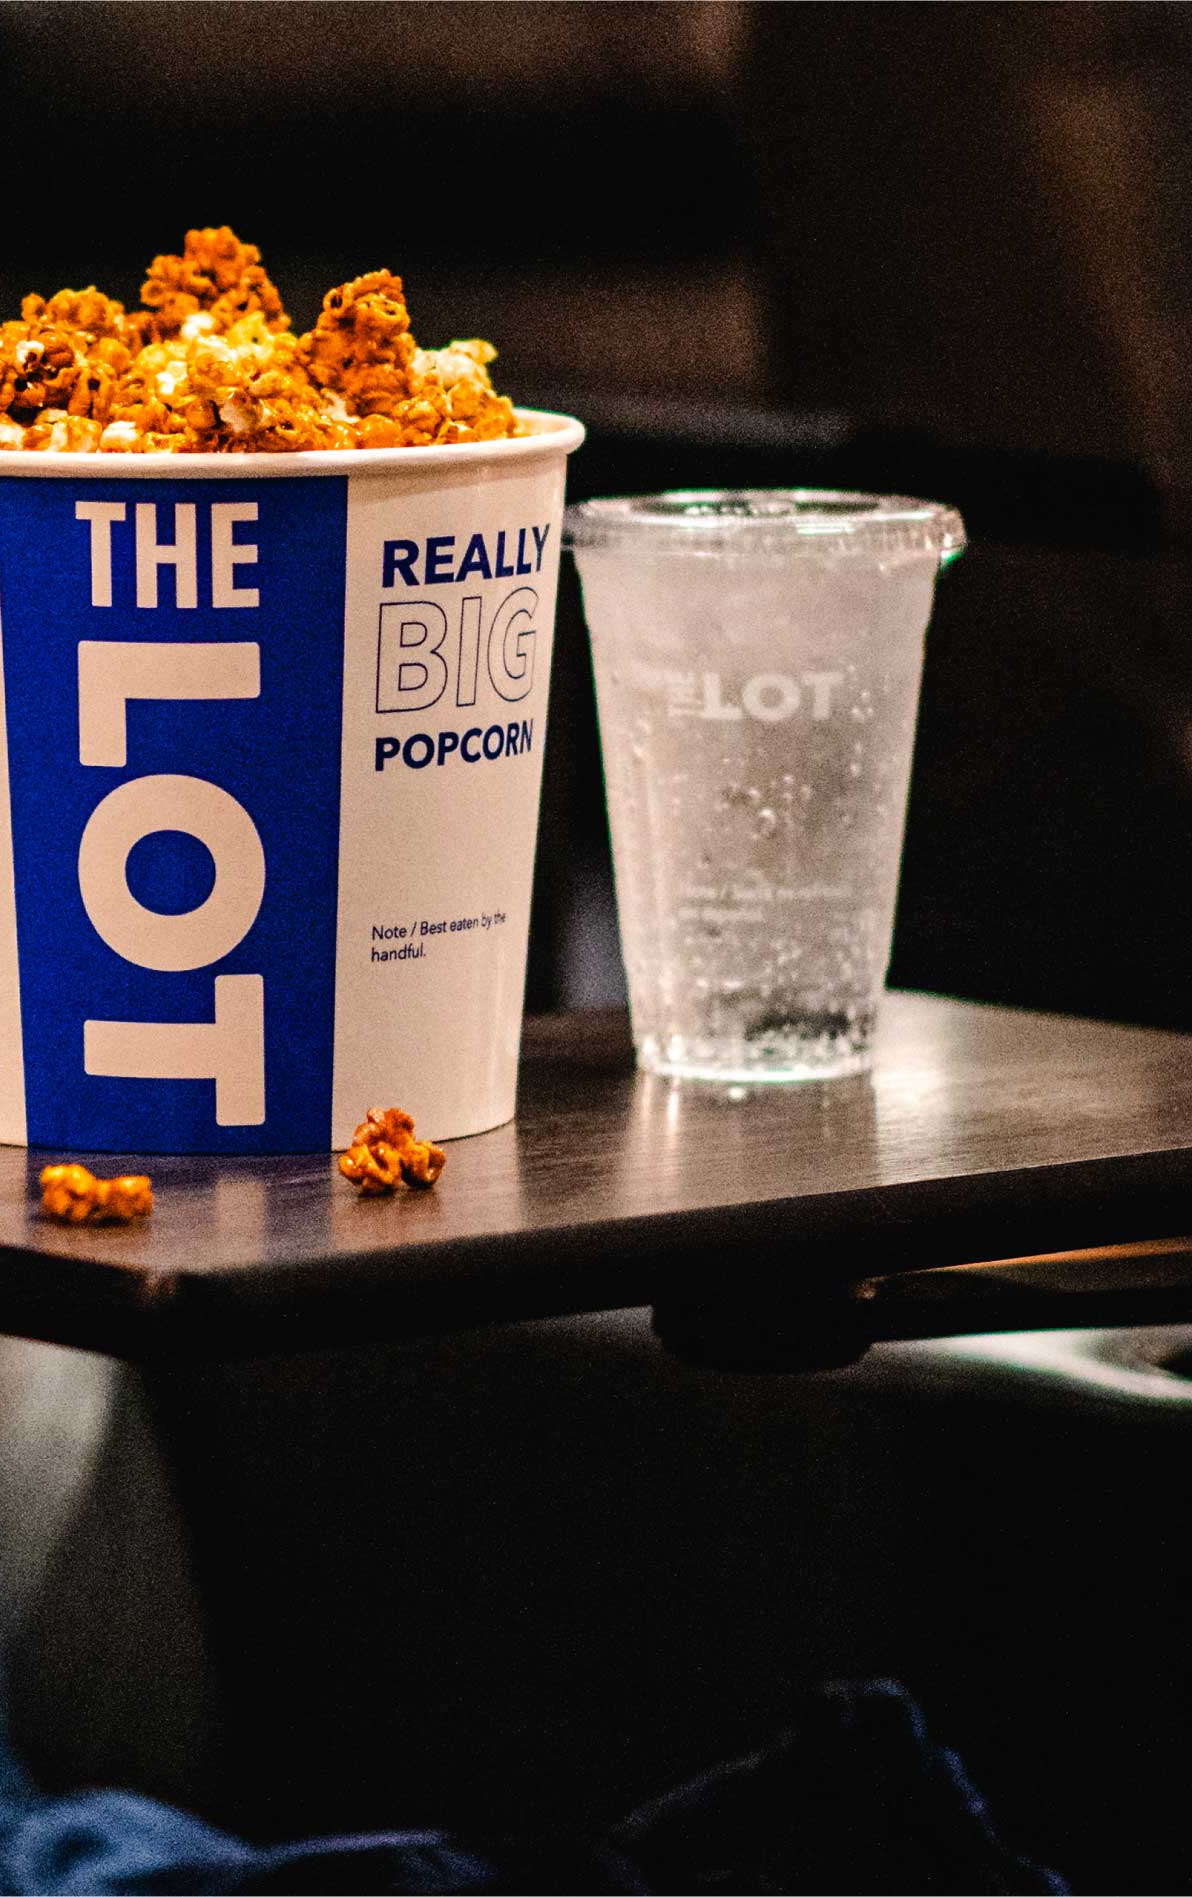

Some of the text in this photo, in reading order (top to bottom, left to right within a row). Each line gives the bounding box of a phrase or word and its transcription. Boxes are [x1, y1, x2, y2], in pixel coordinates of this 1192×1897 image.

[75, 501, 260, 609] THE
[382, 523, 550, 588] REALLY
[375, 586, 539, 713] BIG
[696, 671, 845, 722] LOT
[375, 718, 534, 772] POPCORN
[77, 641, 266, 1127] LOT
[371, 942, 426, 963] handful.
[372, 925, 407, 941] Note
[420, 921, 447, 936] Best
[450, 917, 479, 932] eaten
[481, 912, 492, 930] by
[494, 909, 506, 925] the
